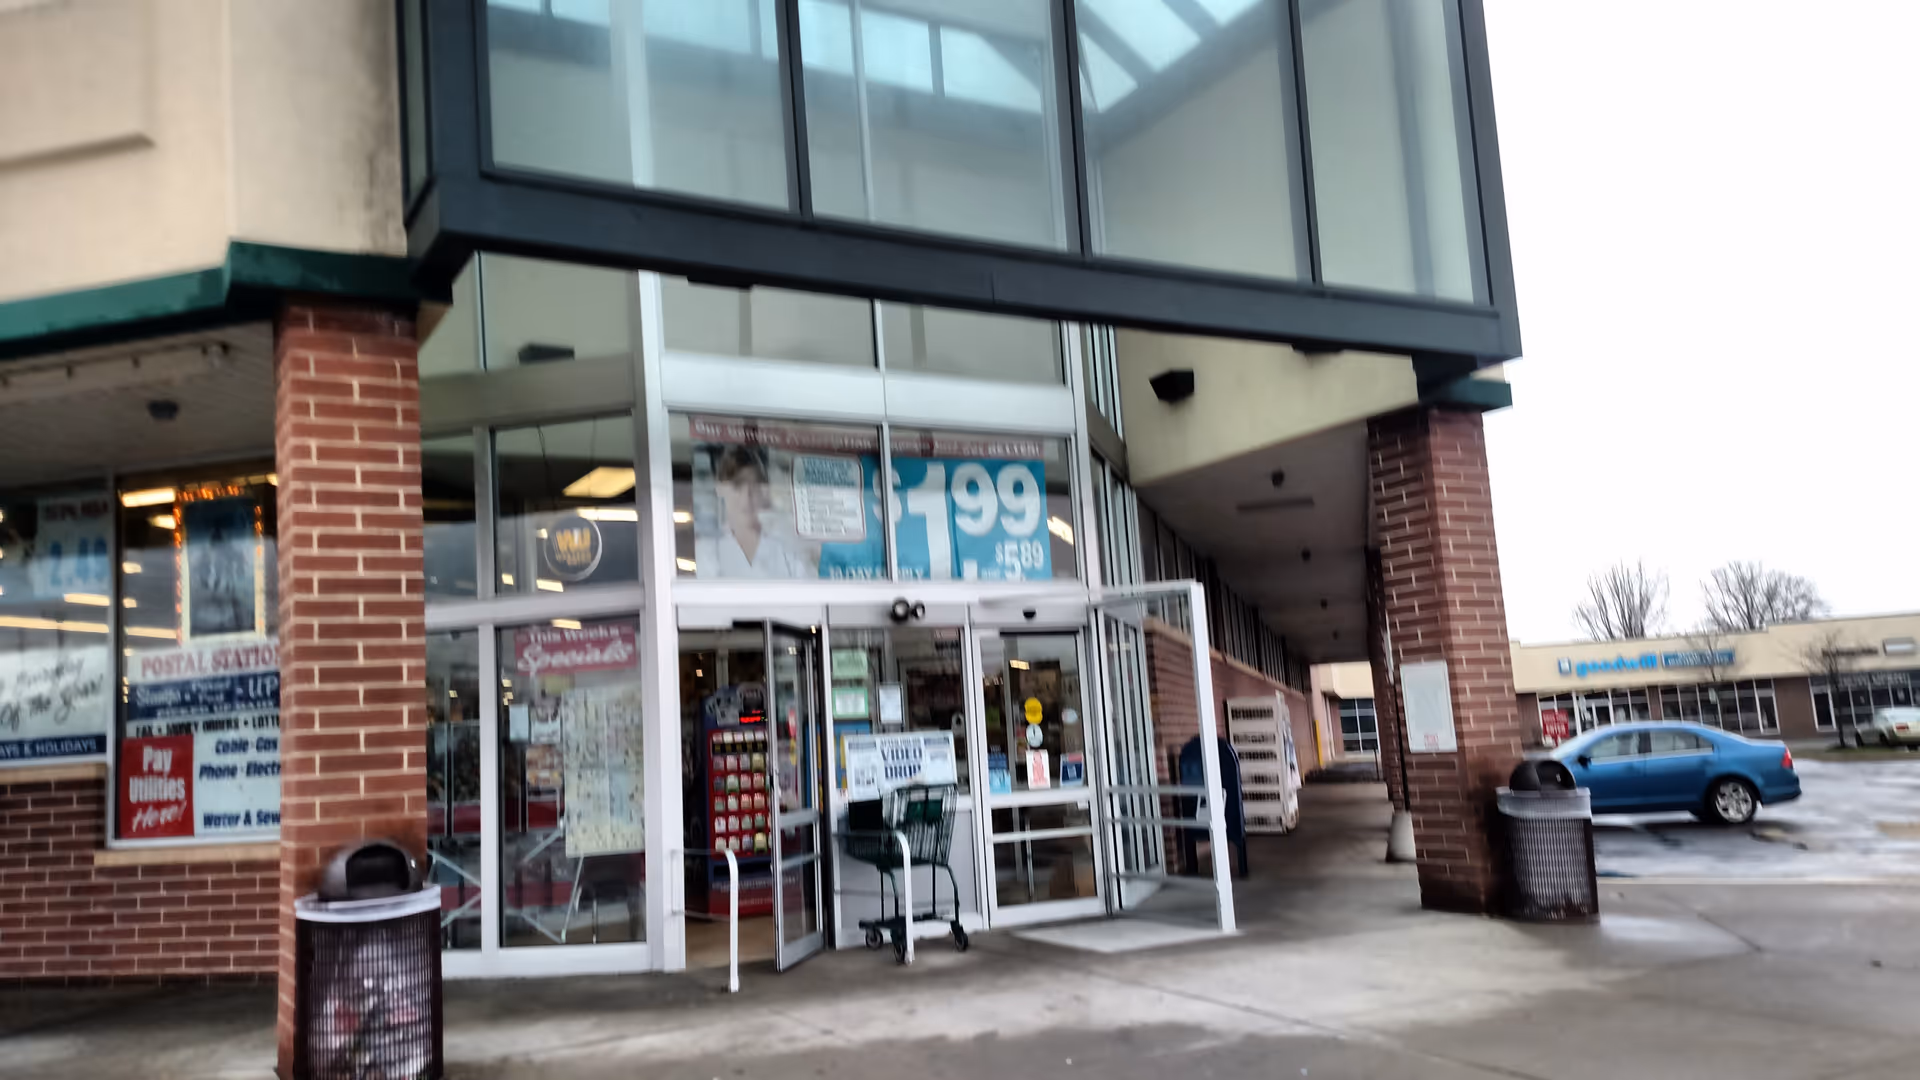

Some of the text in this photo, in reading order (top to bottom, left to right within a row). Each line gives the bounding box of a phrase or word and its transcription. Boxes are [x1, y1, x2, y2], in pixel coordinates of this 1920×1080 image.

[141, 652, 207, 678] POSTAL
[1575, 653, 1658, 678] goodwill
[36, 738, 97, 754] HOLIDAYS
[215, 739, 249, 754] Cable
[881, 747, 922, 761] VIDEO
[142, 745, 173, 778] Pay
[199, 763, 238, 780] Phone
[884, 764, 921, 780] DROP
[129, 776, 186, 804] Utilities
[203, 812, 241, 829] Water
